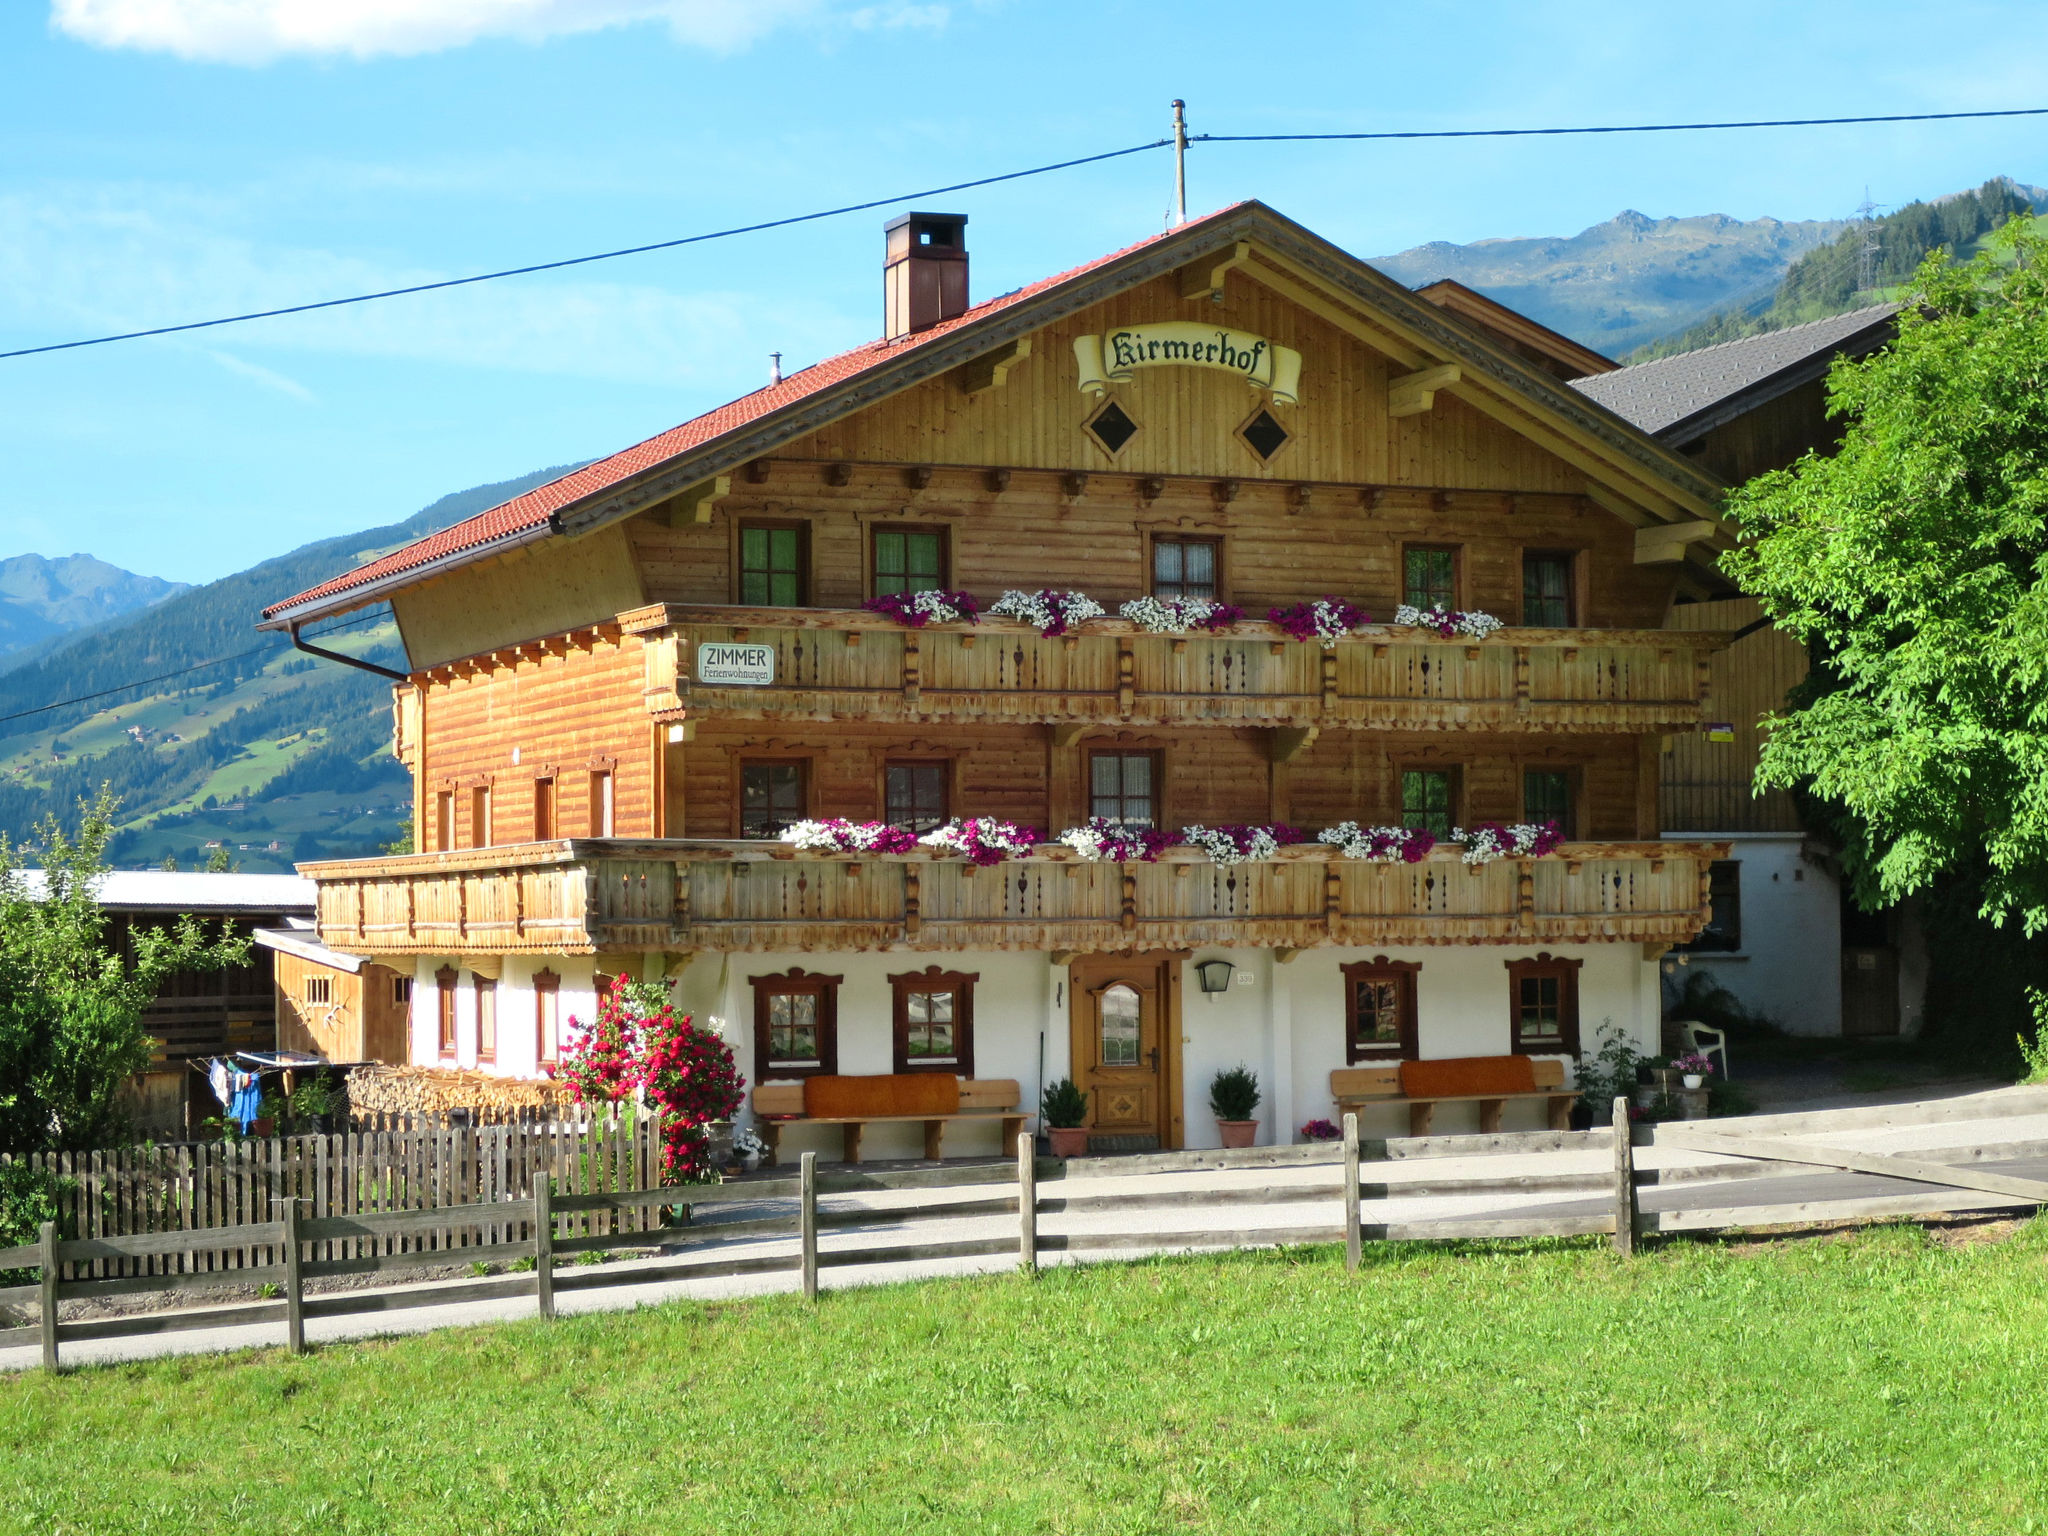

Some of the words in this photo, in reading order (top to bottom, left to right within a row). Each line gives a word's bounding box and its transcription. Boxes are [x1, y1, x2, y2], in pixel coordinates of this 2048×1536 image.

[1111, 331, 1266, 375] Kirmerhof
[707, 648, 766, 666] ZIMMER
[704, 666, 768, 681] Ferienwohnungen
